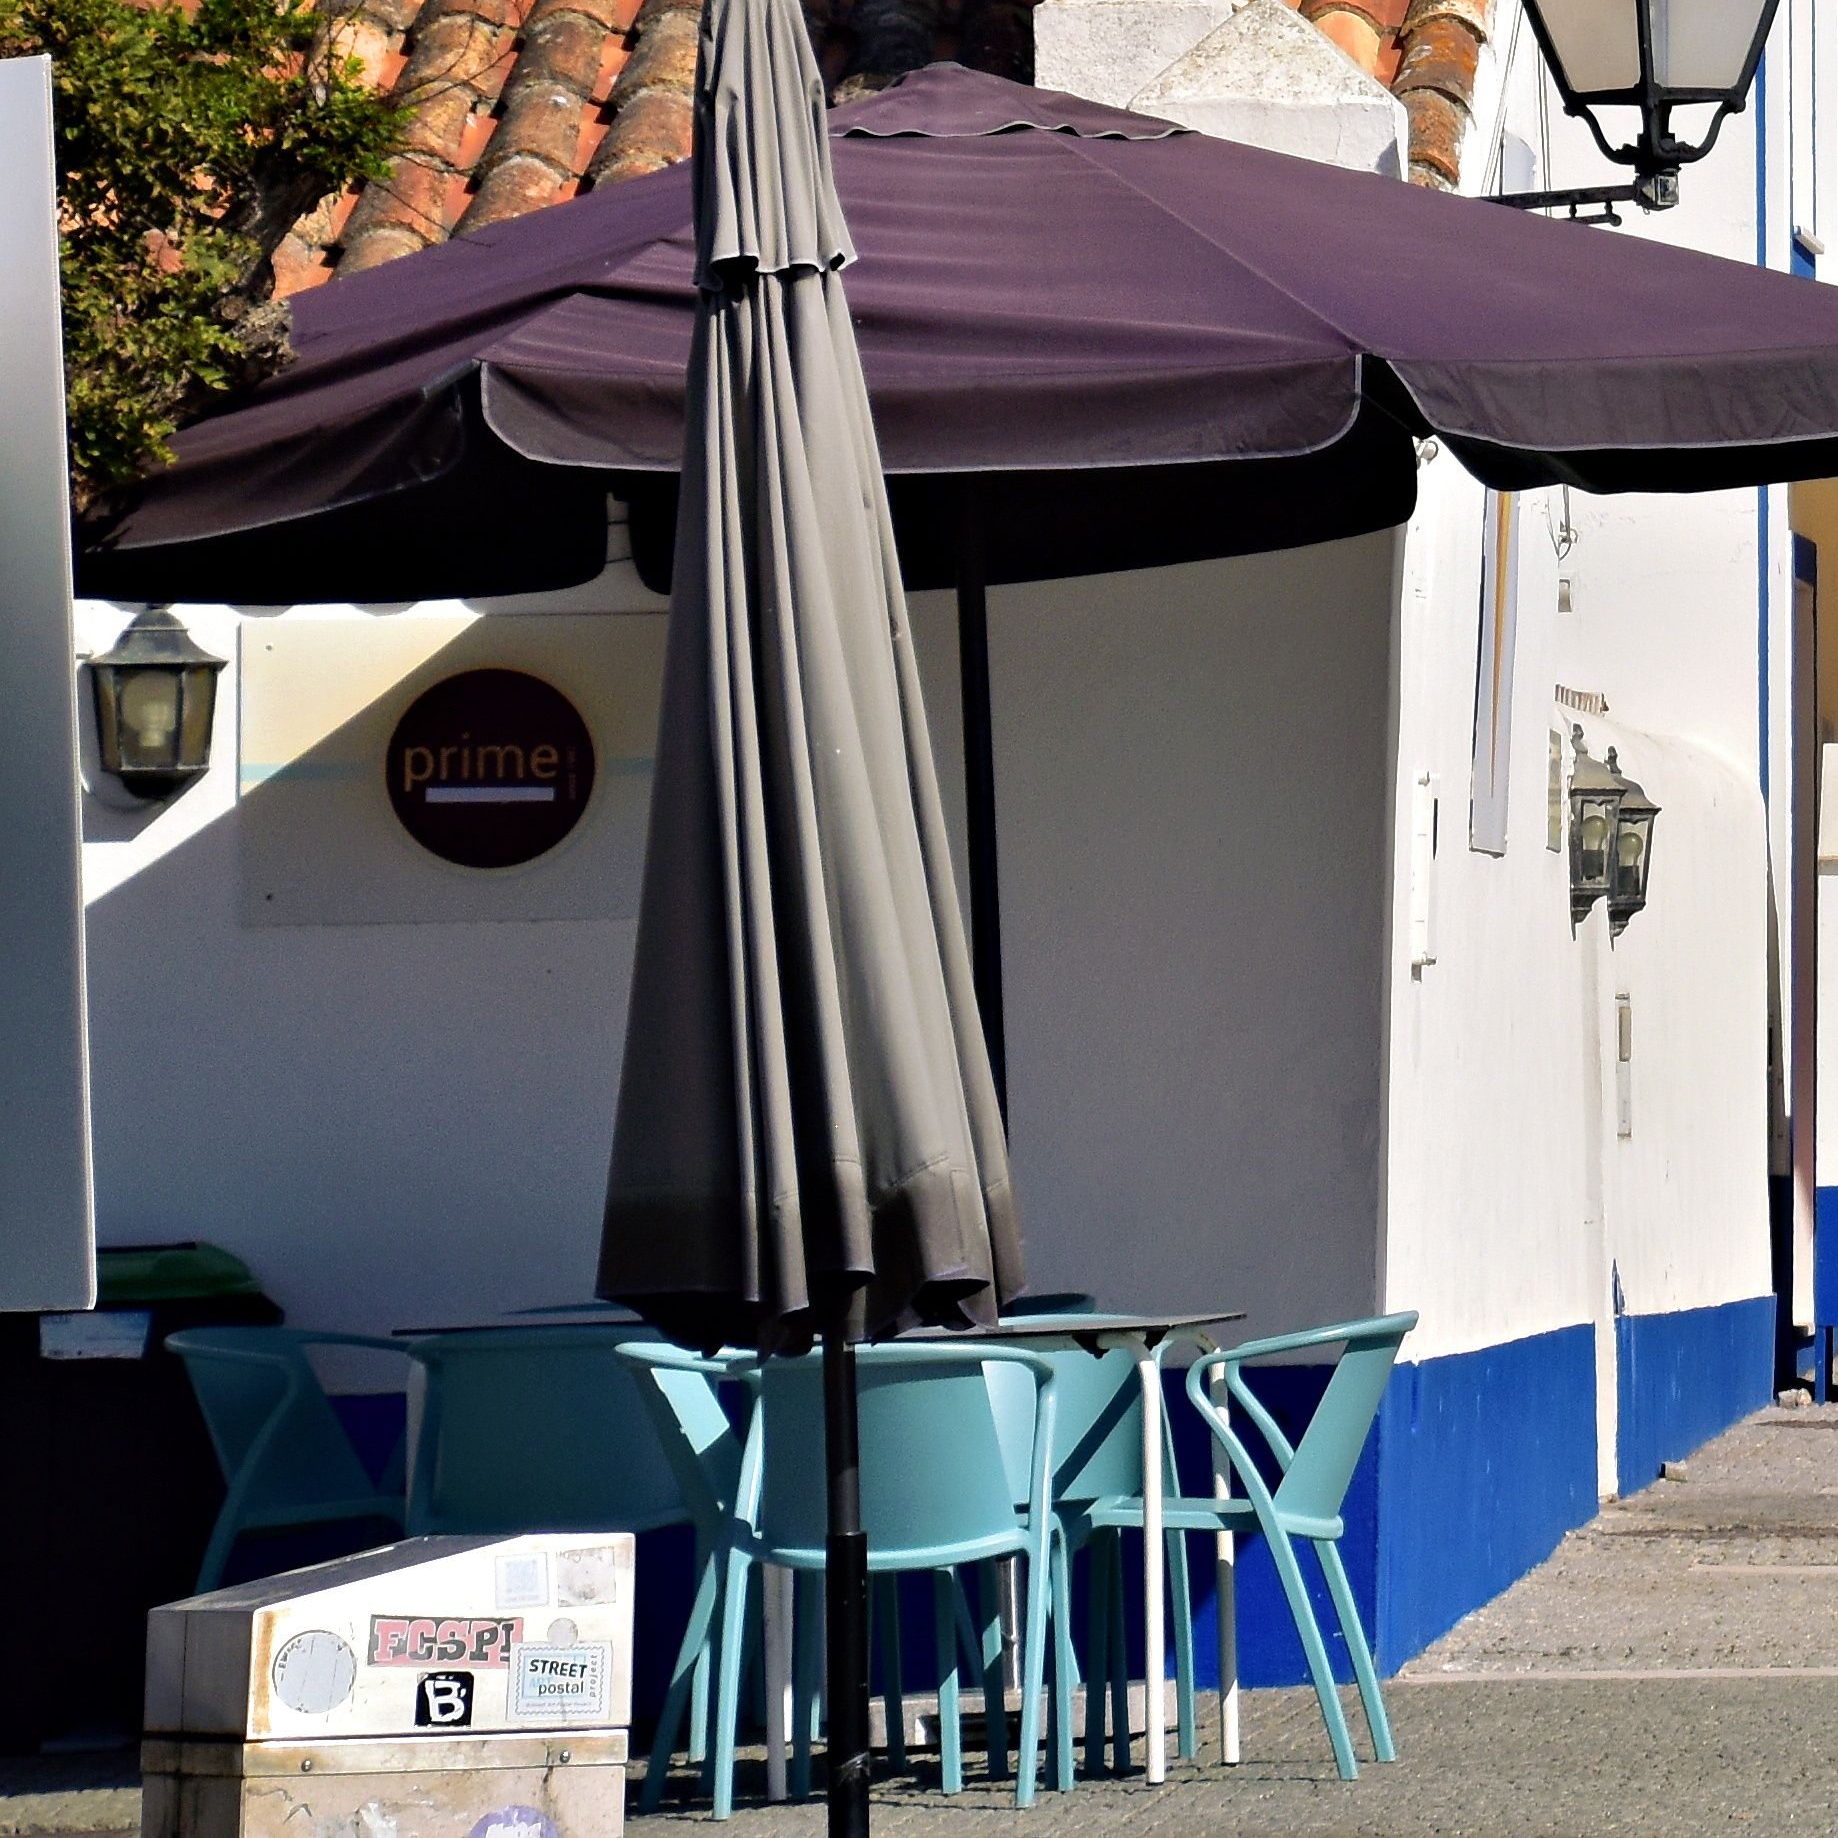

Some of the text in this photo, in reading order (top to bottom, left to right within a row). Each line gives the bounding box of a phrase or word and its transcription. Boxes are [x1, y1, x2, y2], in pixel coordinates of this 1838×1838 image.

[404, 732, 560, 793] prime
[528, 1659, 588, 1679] STREET
[588, 1654, 599, 1698] project
[538, 1681, 584, 1697] postal
